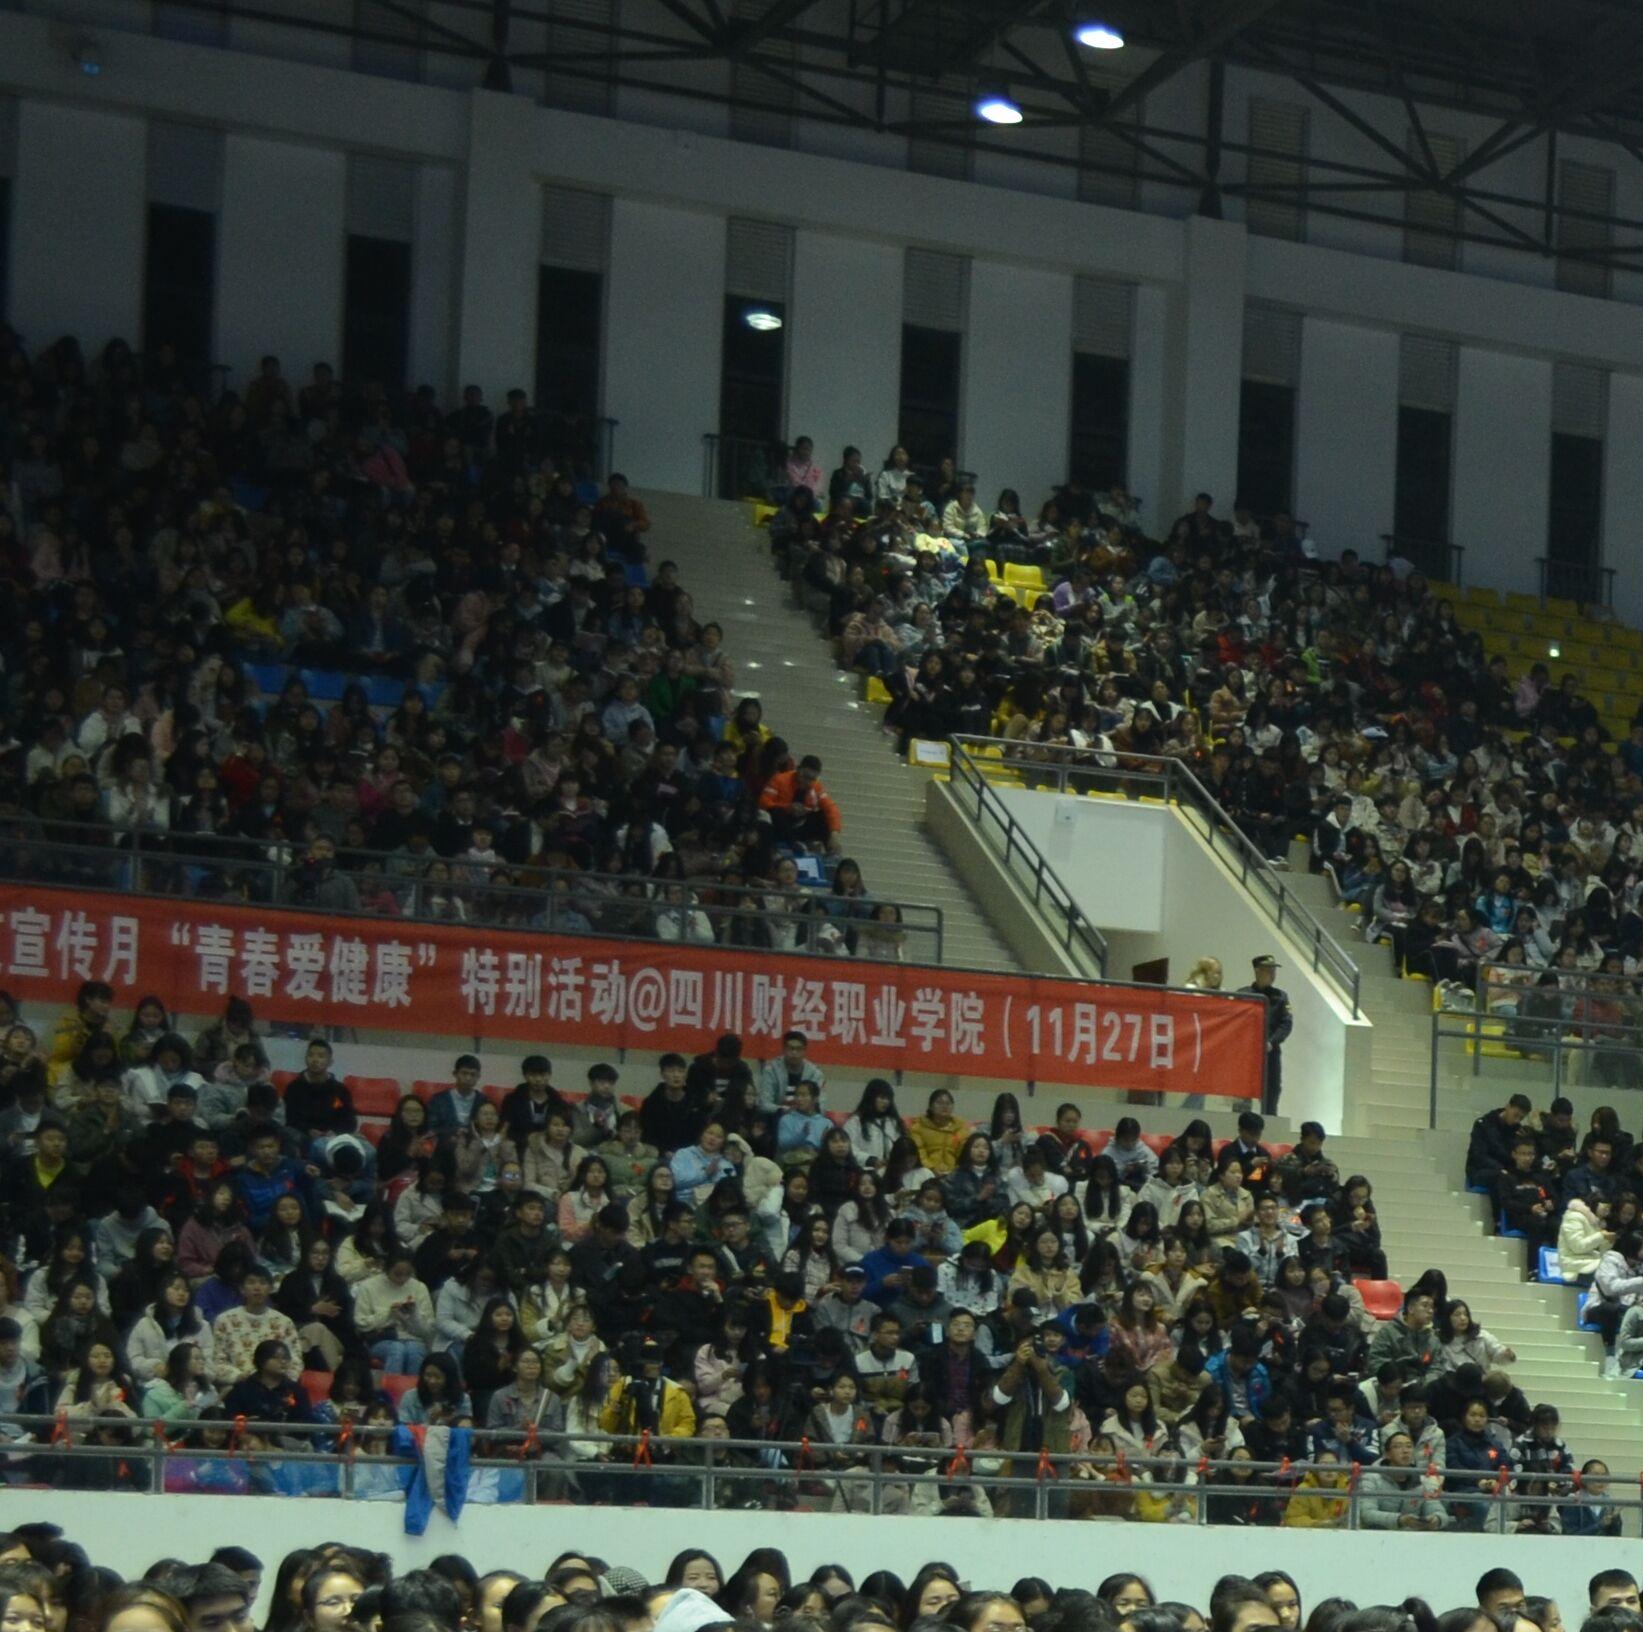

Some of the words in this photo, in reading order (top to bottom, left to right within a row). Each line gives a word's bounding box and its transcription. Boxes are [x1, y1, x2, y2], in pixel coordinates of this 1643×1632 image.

[0, 906, 1202, 1073] 宣传月“青春爱健康”特别活动@四川财经职业学院（11月27日）
